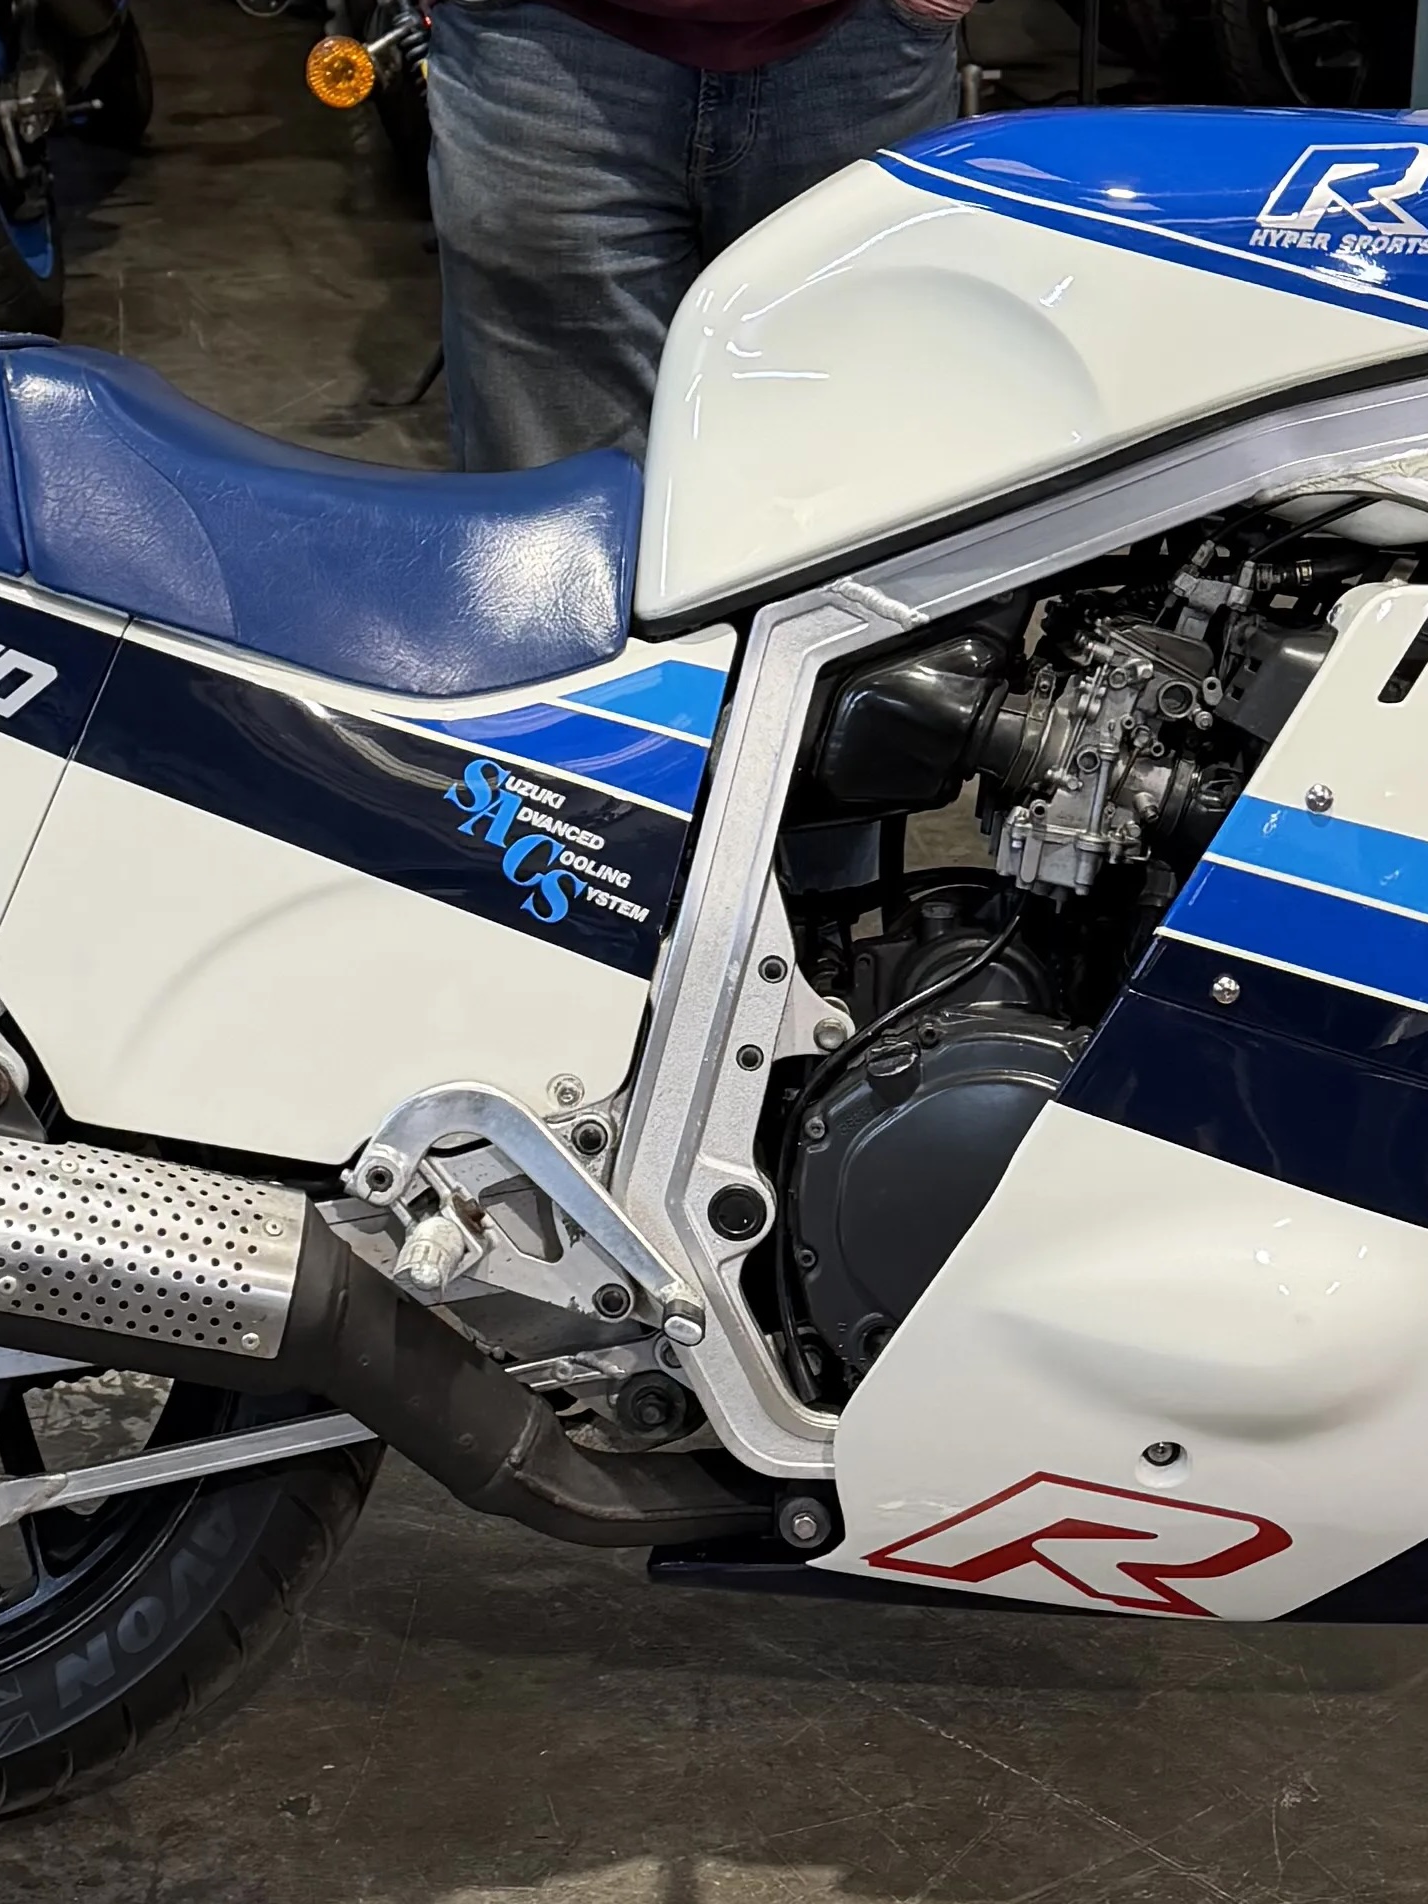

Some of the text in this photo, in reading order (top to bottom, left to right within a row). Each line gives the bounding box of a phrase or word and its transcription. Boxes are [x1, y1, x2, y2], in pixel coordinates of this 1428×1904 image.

[1249, 229, 1332, 251] HYPER
[444, 759, 567, 813] SUZUKI
[457, 787, 605, 850] ADVANCED
[502, 834, 632, 889] COOLING
[520, 869, 651, 924] SYSTEM
[859, 1471, 1293, 1618] R
[55, 1492, 239, 1711] AVON
